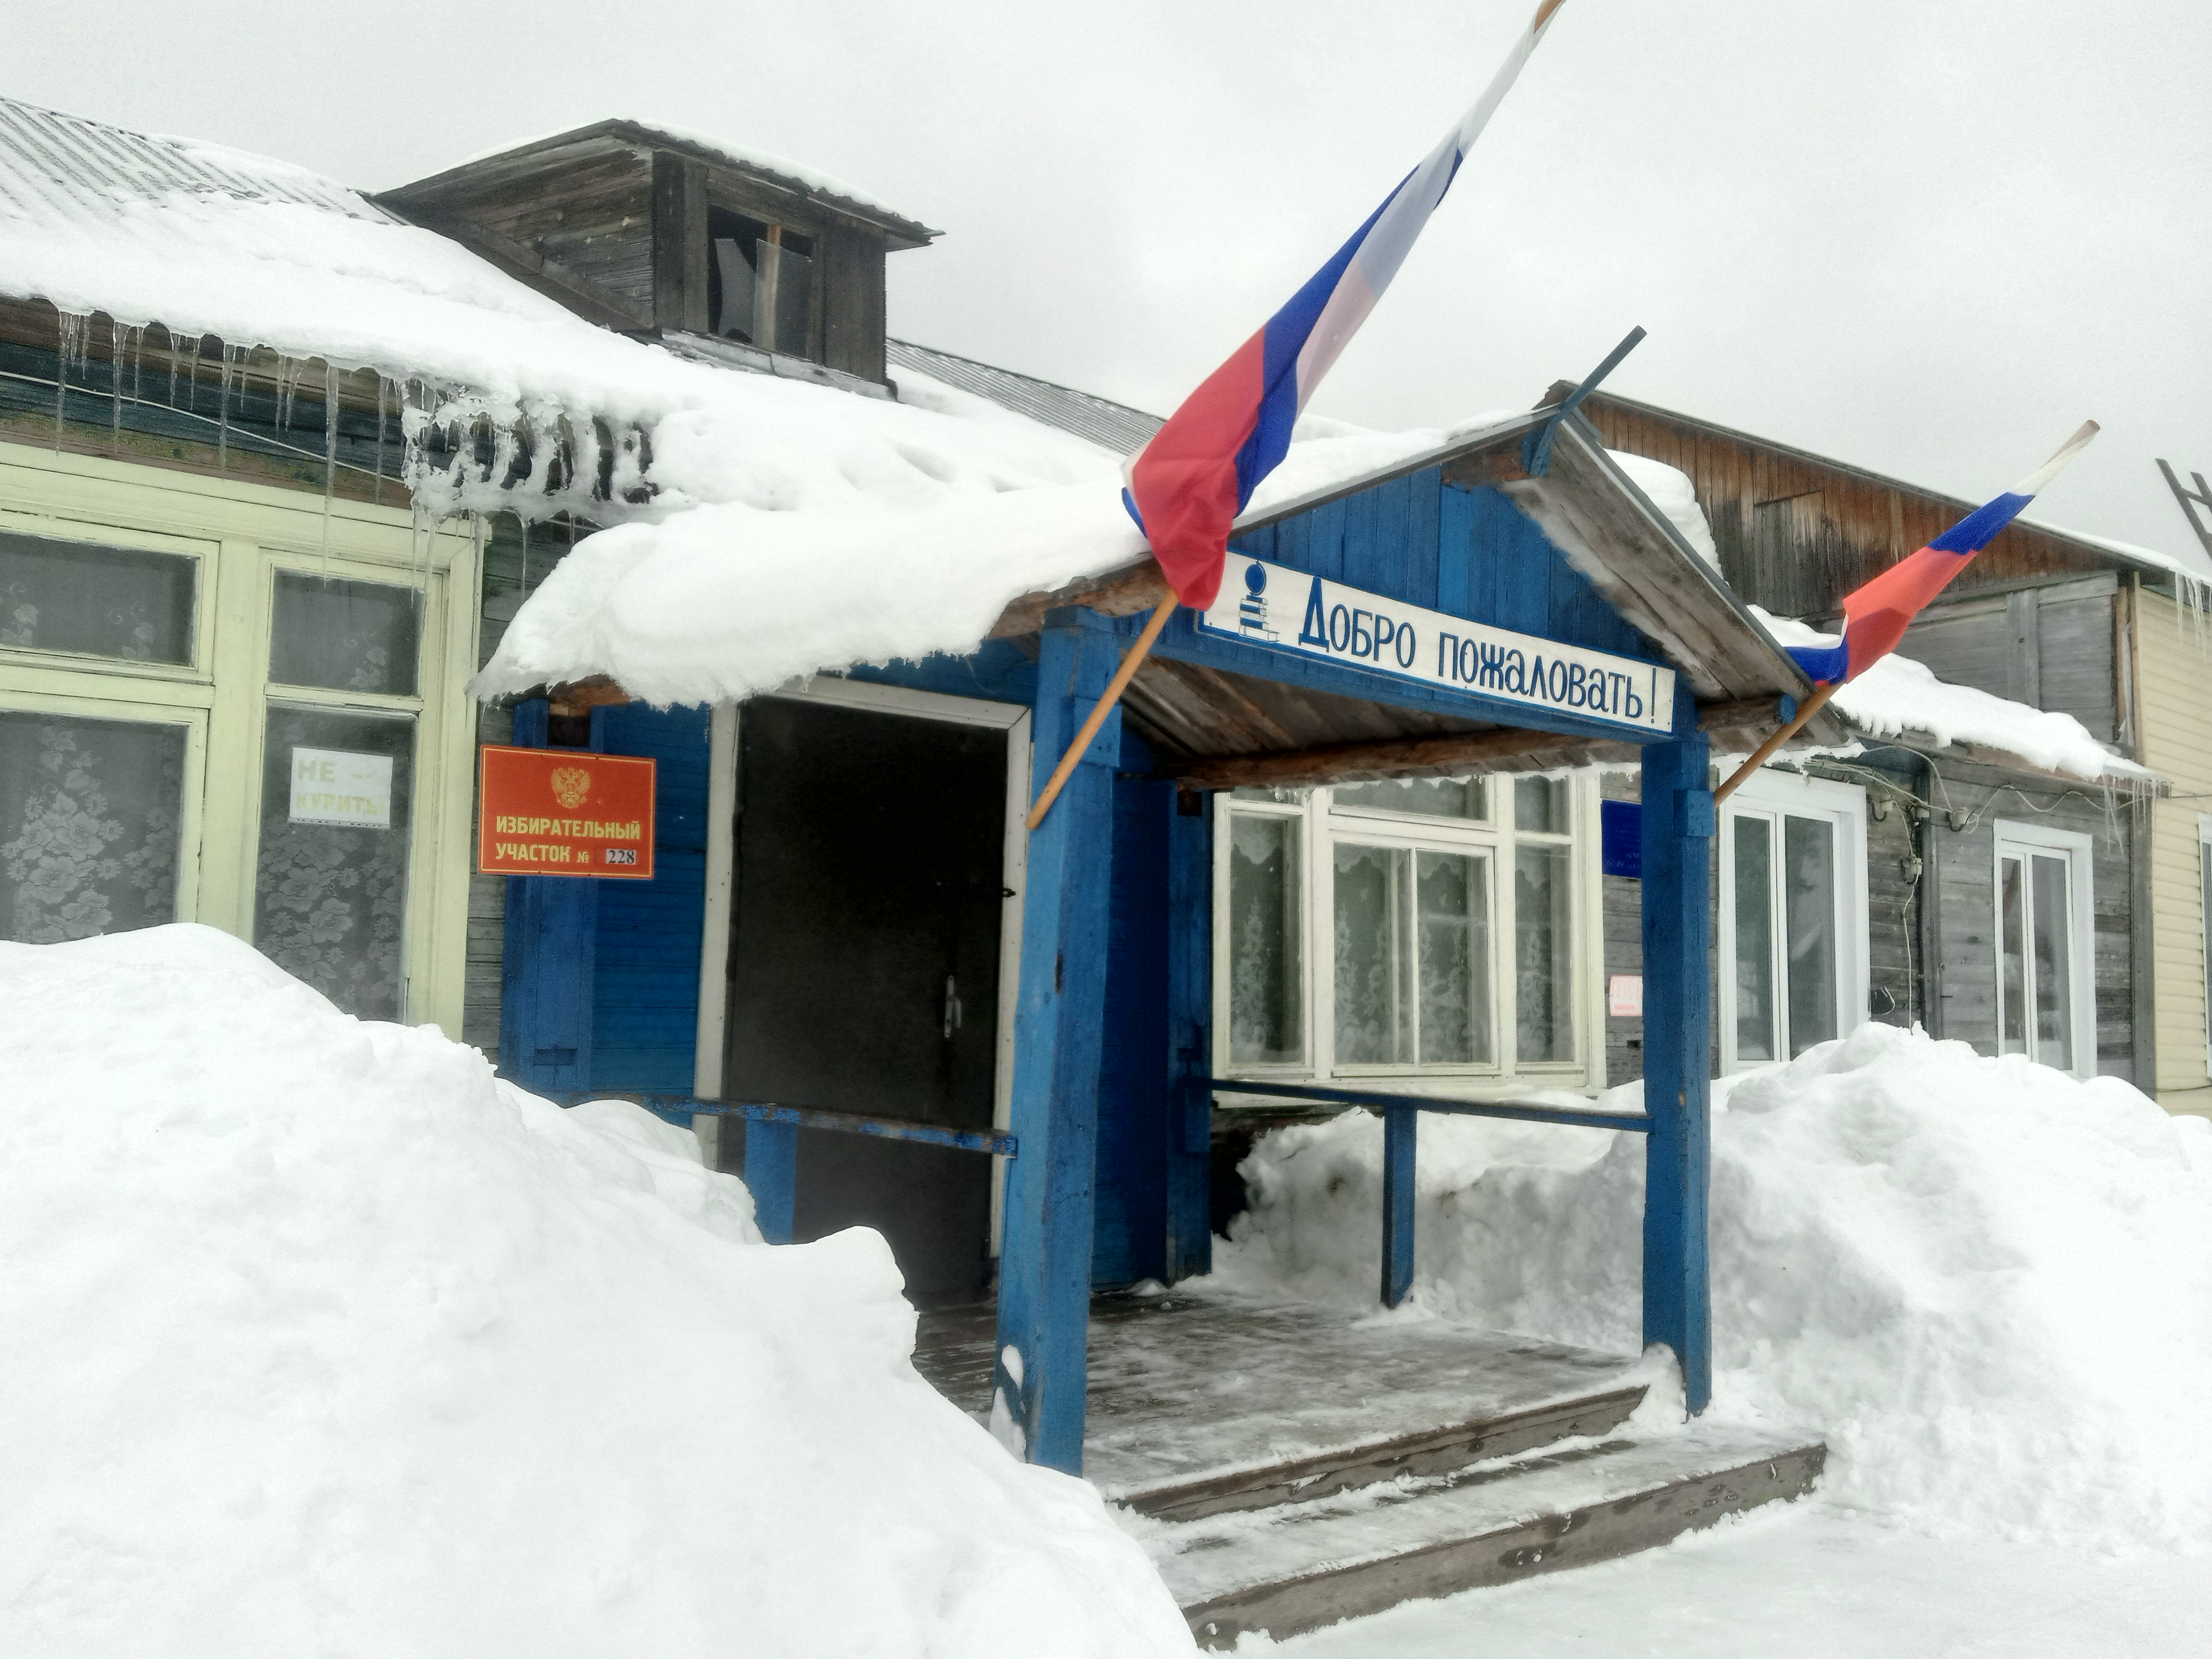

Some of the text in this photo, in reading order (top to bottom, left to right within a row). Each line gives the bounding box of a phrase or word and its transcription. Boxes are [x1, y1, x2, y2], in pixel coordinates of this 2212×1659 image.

[297, 760, 335, 782] НЕ
[496, 816, 641, 840] ИЗБИРАТЕЛЬНЫЙ
[495, 843, 636, 865] УЧАСТОК № 228
